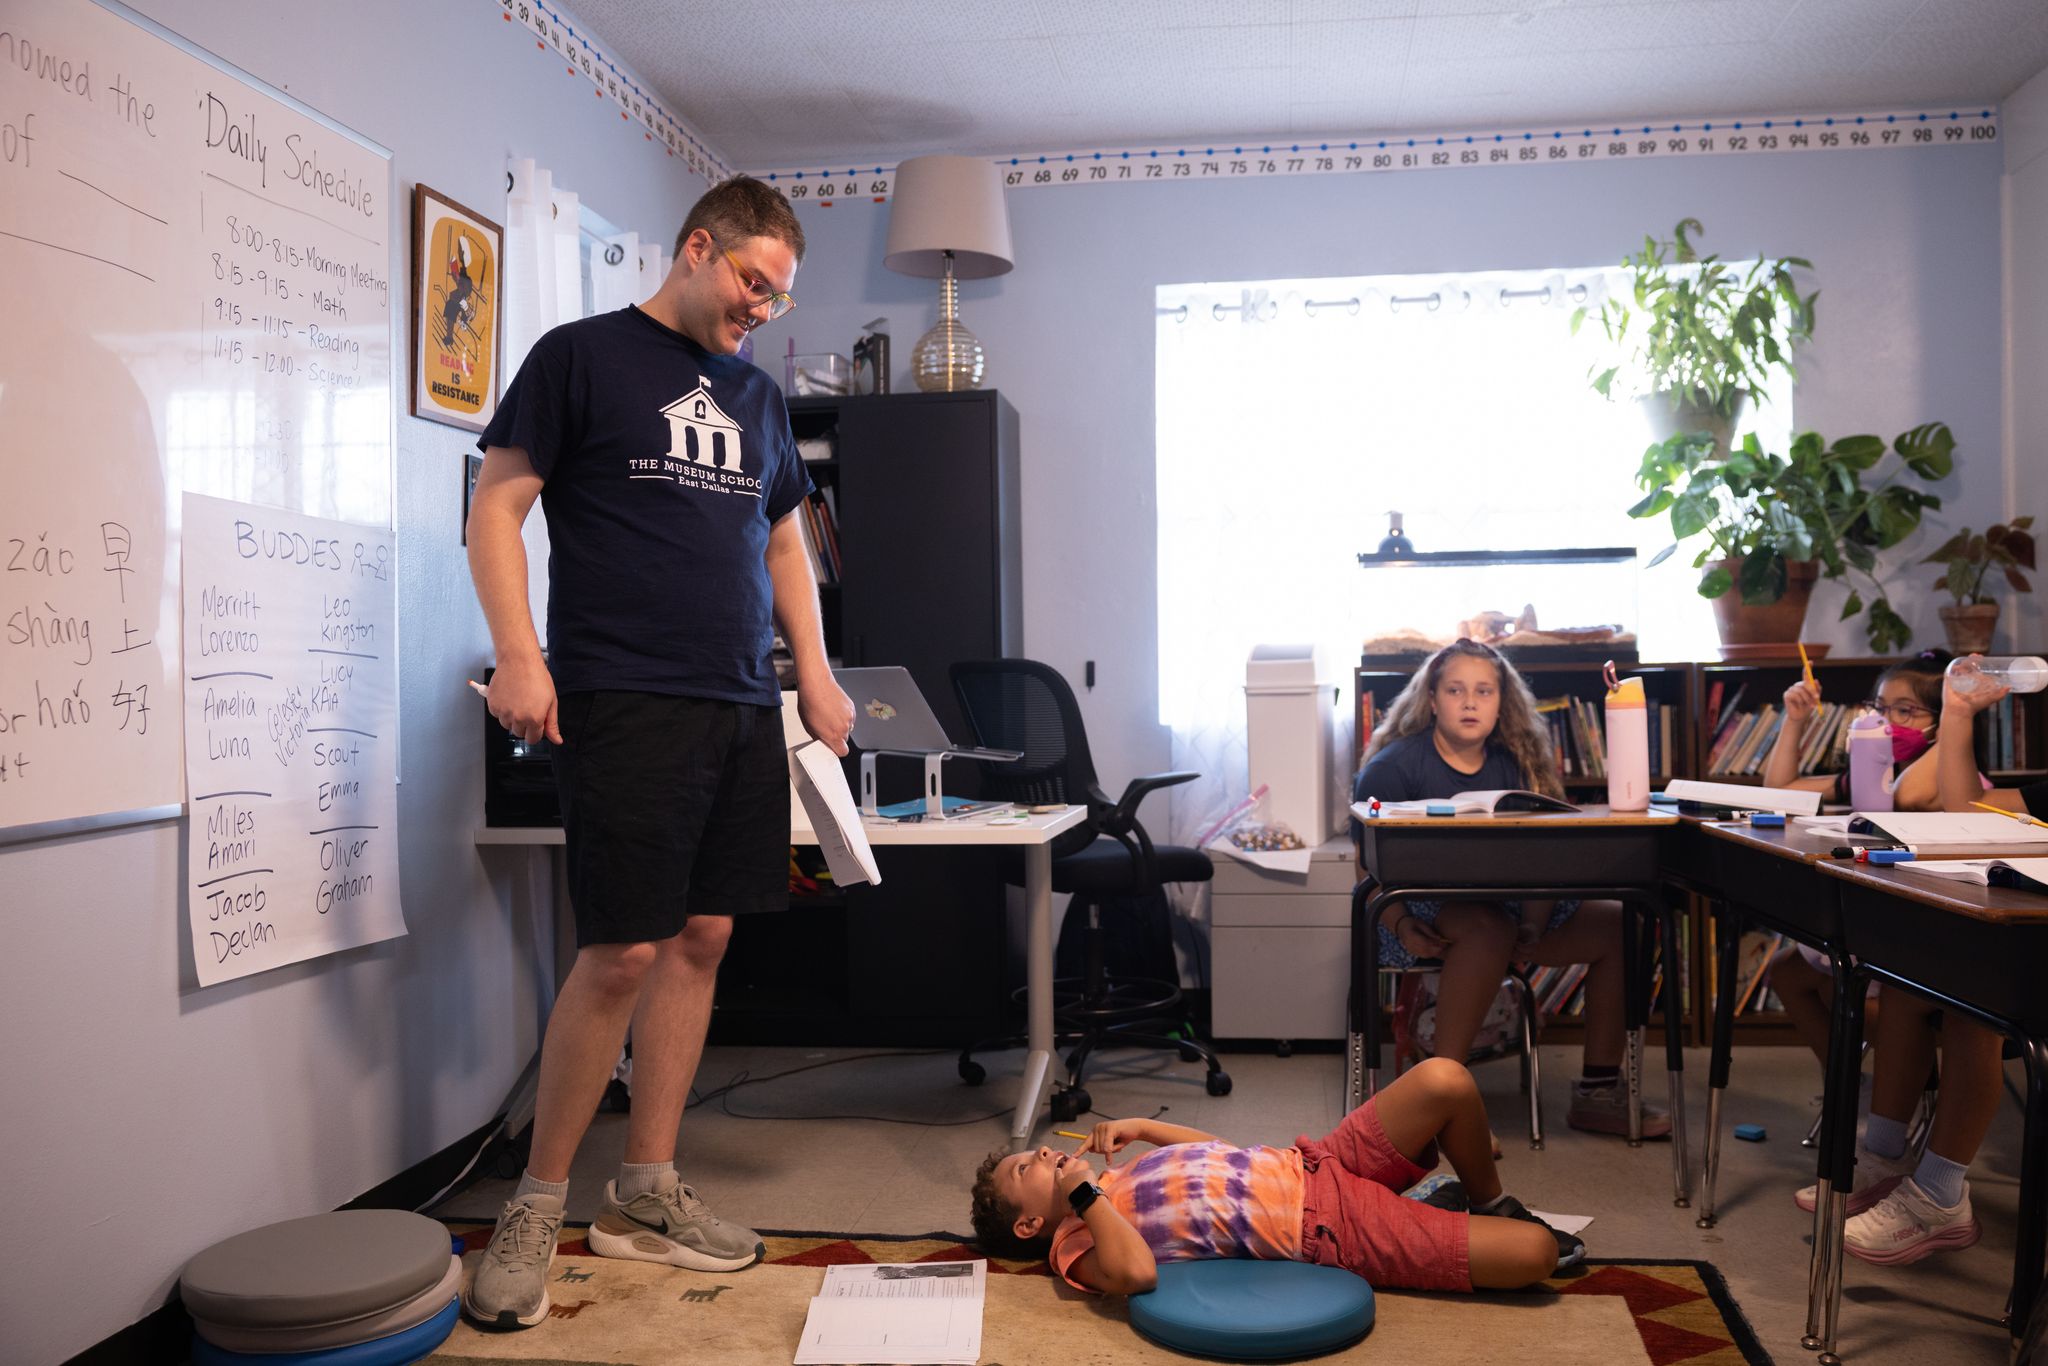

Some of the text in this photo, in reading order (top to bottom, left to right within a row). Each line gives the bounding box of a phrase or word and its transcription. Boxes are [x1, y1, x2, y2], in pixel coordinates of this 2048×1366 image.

[518, 3, 529, 22] 39
[535, 14, 547, 36] 40
[552, 30, 560, 48] 41
[567, 42, 576, 63] 42
[581, 55, 590, 74] 43
[595, 67, 604, 86] 44
[608, 78, 616, 97] 45
[621, 89, 629, 108] 46
[633, 100, 641, 117] 47
[108, 74, 156, 138] the
[2, 114, 34, 168] of
[205, 91, 374, 217] Daily Schedule
[1005, 124, 1997, 186] 67 68 69 70 71 72 73 74 75 76 77 78 79 80 81 82 83 84 85 86 87 88 89 90 91 92 93 94 95 96 97 98 99 100
[791, 184, 809, 199] 59
[816, 183, 836, 198] 60
[843, 181, 858, 196] 61
[870, 180, 888, 194] 62
[351, 263, 388, 307] Meeting
[313, 290, 347, 321] Math
[309, 323, 360, 371] Reading
[432, 380, 480, 406] RESISTANCE
[451, 371, 461, 385] IS
[629, 459, 659, 470] THE
[663, 460, 717, 482] MUSEUM
[678, 475, 730, 494] East Dallas
[235, 519, 342, 571] BUDDIES
[202, 585, 261, 620] Merritt
[324, 593, 351, 619] Leo
[111, 618, 152, 654] 上
[200, 623, 259, 657] Lorenzo
[112, 679, 151, 735] 好
[204, 687, 257, 723] Amelia
[208, 729, 251, 761] Luna
[313, 741, 360, 767] Scout
[318, 780, 360, 812] Emma
[207, 804, 255, 841] Miles
[208, 830, 256, 871] Amari
[320, 837, 369, 871] Oliver
[206, 883, 266, 921] Jacob
[316, 874, 374, 915] Graham
[209, 921, 277, 964] Declan
